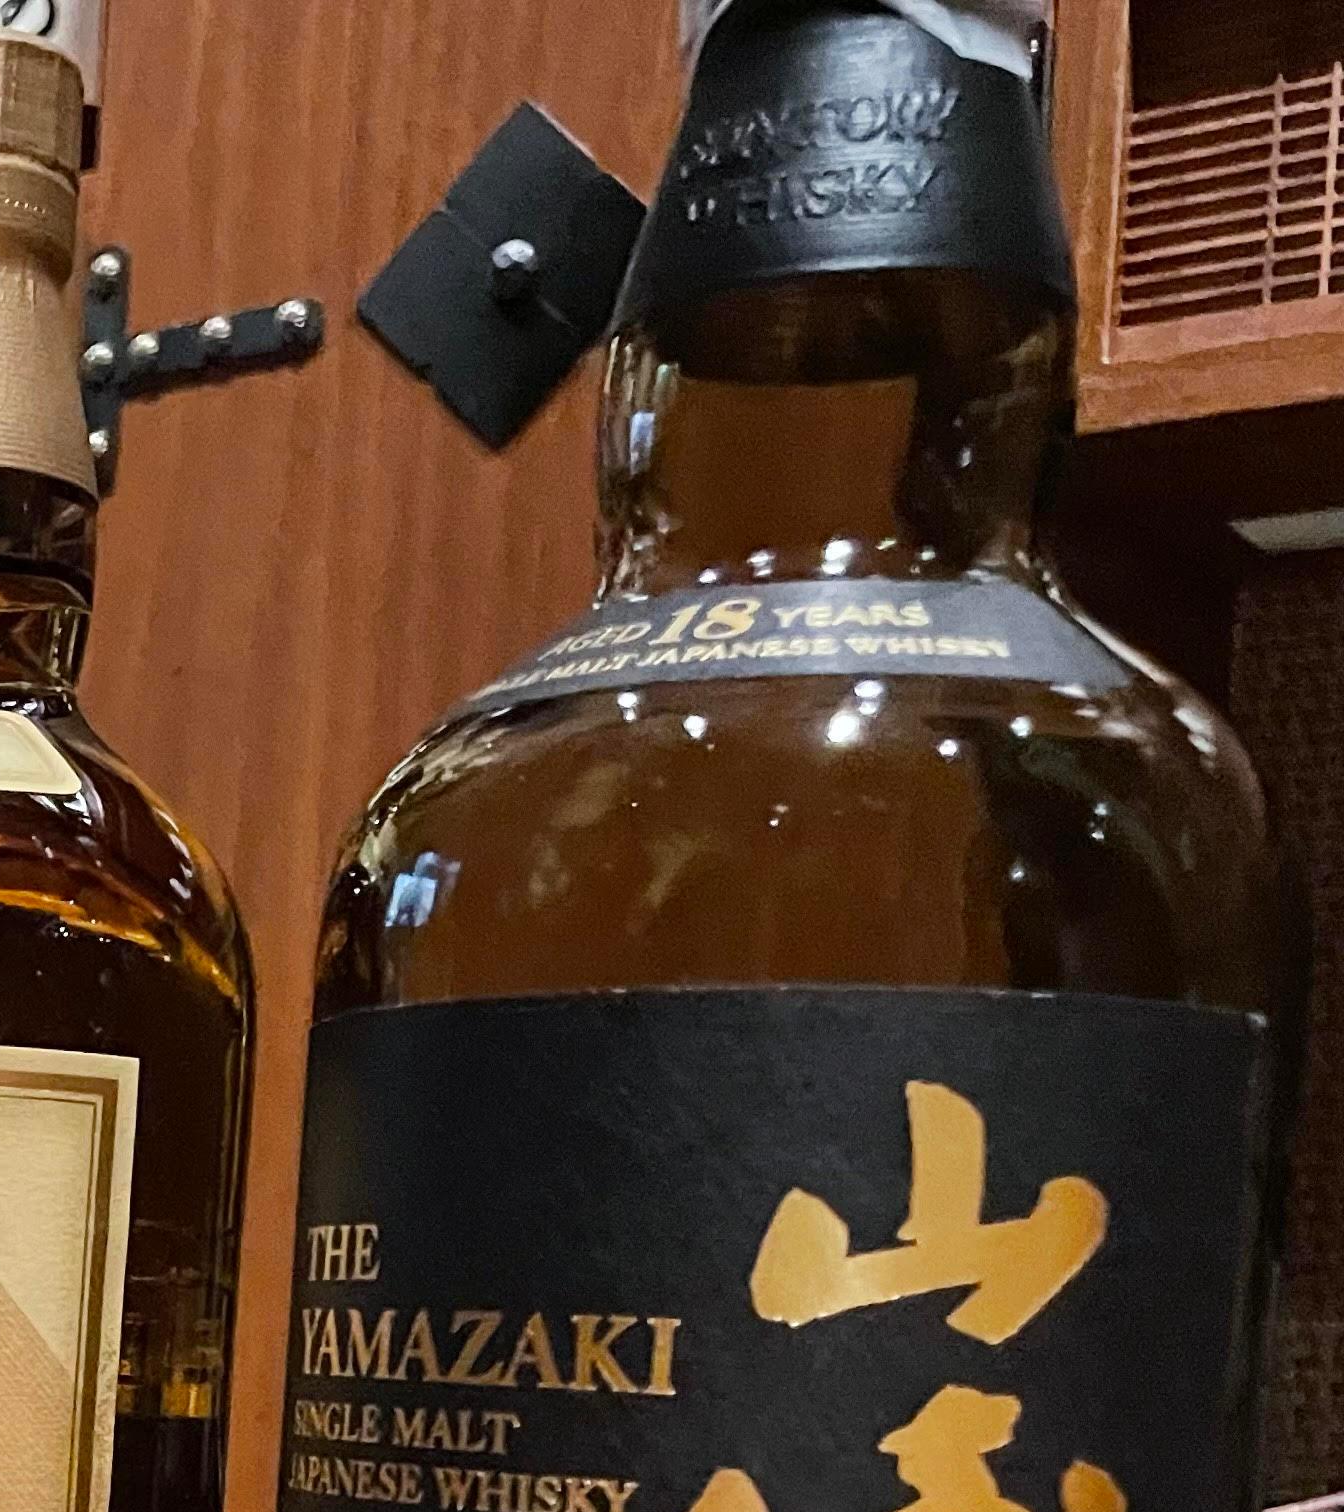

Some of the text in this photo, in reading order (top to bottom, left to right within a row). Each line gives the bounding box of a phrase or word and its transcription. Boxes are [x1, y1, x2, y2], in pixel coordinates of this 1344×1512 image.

[648, 597, 762, 646] 18
[772, 601, 933, 629] YEARS
[636, 636, 840, 668] JAPANESE
[307, 1223, 381, 1282] THE
[302, 1307, 682, 1396] YAMAZAKI
[293, 1400, 521, 1455] SINGLE MALT
[288, 1454, 424, 1504] JAPANESE
